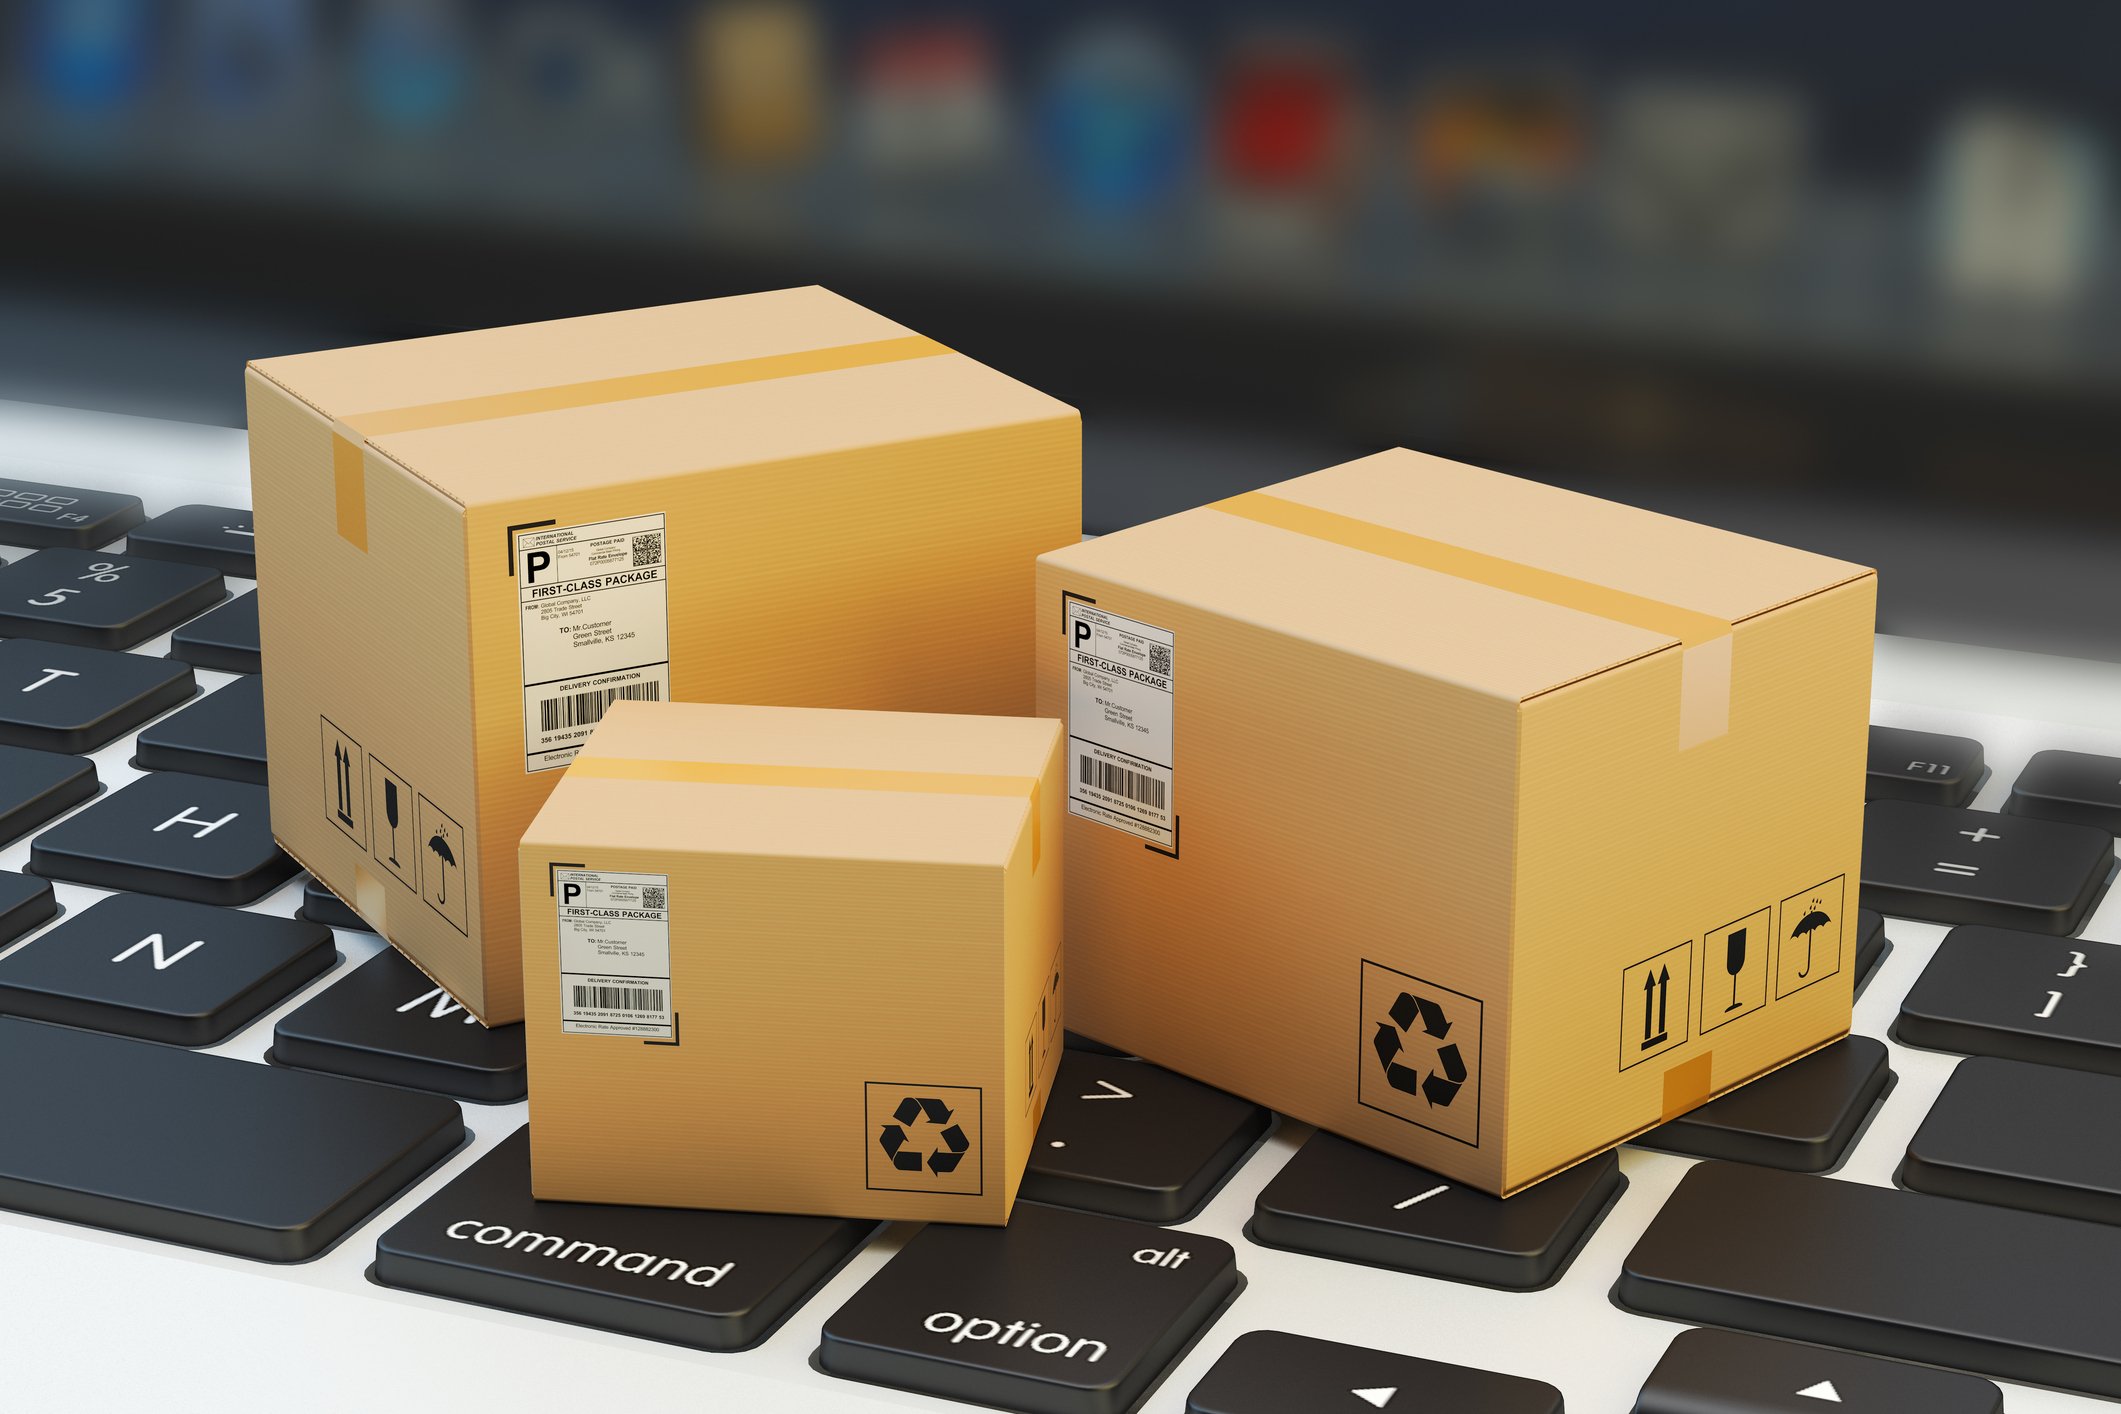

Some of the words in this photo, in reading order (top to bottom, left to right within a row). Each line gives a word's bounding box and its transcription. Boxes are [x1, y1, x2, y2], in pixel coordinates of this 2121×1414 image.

[57, 513, 88, 522] F4
[536, 531, 573, 541] INTERNATIONAL
[536, 539, 556, 547] POSTAL
[590, 539, 612, 547] POSTAGE
[79, 563, 129, 582] %
[527, 551, 551, 584] P
[532, 578, 602, 598] FIRST-CLASS
[605, 569, 657, 586] PACKAGE
[28, 589, 80, 605] 5
[560, 626, 571, 634] TO:
[573, 630, 592, 640] Green
[594, 627, 612, 636] Street
[1075, 620, 1091, 648] P
[573, 637, 603, 648] Smallville,
[617, 631, 635, 640] 12345
[1078, 653, 1126, 676] FIRST-CLASS
[1129, 669, 1167, 689] PACKAGE
[22, 669, 79, 691] T
[560, 681, 590, 691] DELIVERY
[593, 672, 641, 686] CONFIRMATION
[1105, 707, 1118, 717] Green
[1120, 712, 1133, 722] Street
[1127, 721, 1134, 729] KS
[541, 736, 552, 744] 356
[554, 733, 572, 742] 19435
[573, 730, 588, 739] 2091
[544, 751, 573, 762] Electronic
[1094, 749, 1116, 760] DELIVERY
[1117, 756, 1152, 772] CONFIRMATION
[1908, 762, 1949, 774] F11
[1103, 795, 1112, 803] 2091
[153, 807, 238, 838] H
[1960, 828, 2000, 841] +
[1934, 863, 1979, 876] =
[564, 883, 581, 904] P
[567, 908, 620, 917] FIRST-CLASS
[622, 911, 662, 919] PACKAGE
[112, 934, 204, 969] N
[2057, 952, 2087, 977] }
[2034, 991, 2062, 1017] ]
[1082, 1081, 1132, 1098] >
[447, 1221, 734, 1287] command
[1133, 1249, 1189, 1268] alt
[925, 1313, 1107, 1362] option
